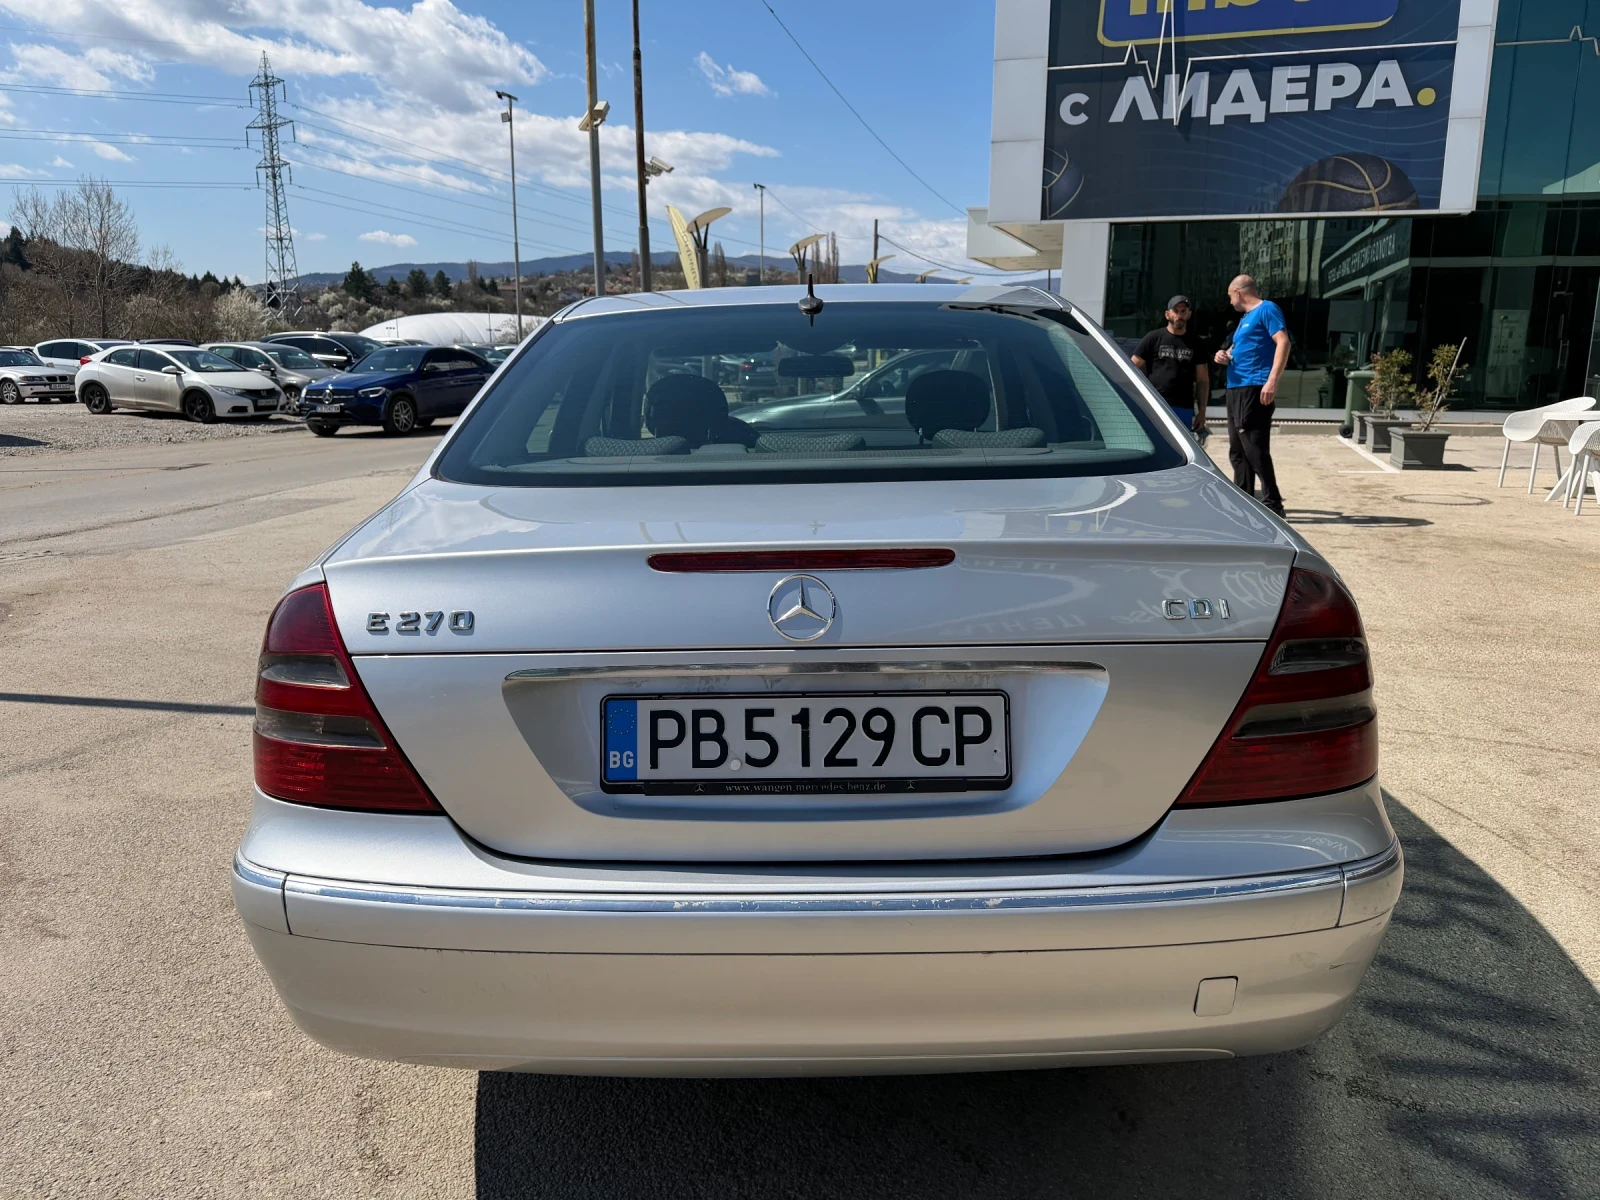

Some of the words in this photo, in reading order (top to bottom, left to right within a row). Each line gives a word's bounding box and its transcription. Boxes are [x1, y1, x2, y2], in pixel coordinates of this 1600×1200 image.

[1108, 59, 1437, 126] ЛИДЕРА.
[1162, 598, 1231, 620] CDI
[367, 611, 390, 632] E
[396, 610, 475, 632] 270
[649, 709, 728, 769] PB
[744, 708, 896, 769] 5129
[911, 706, 992, 767] CP
[609, 750, 634, 769] BG
[725, 781, 887, 792] www.wangen.mercedesbenz.de
